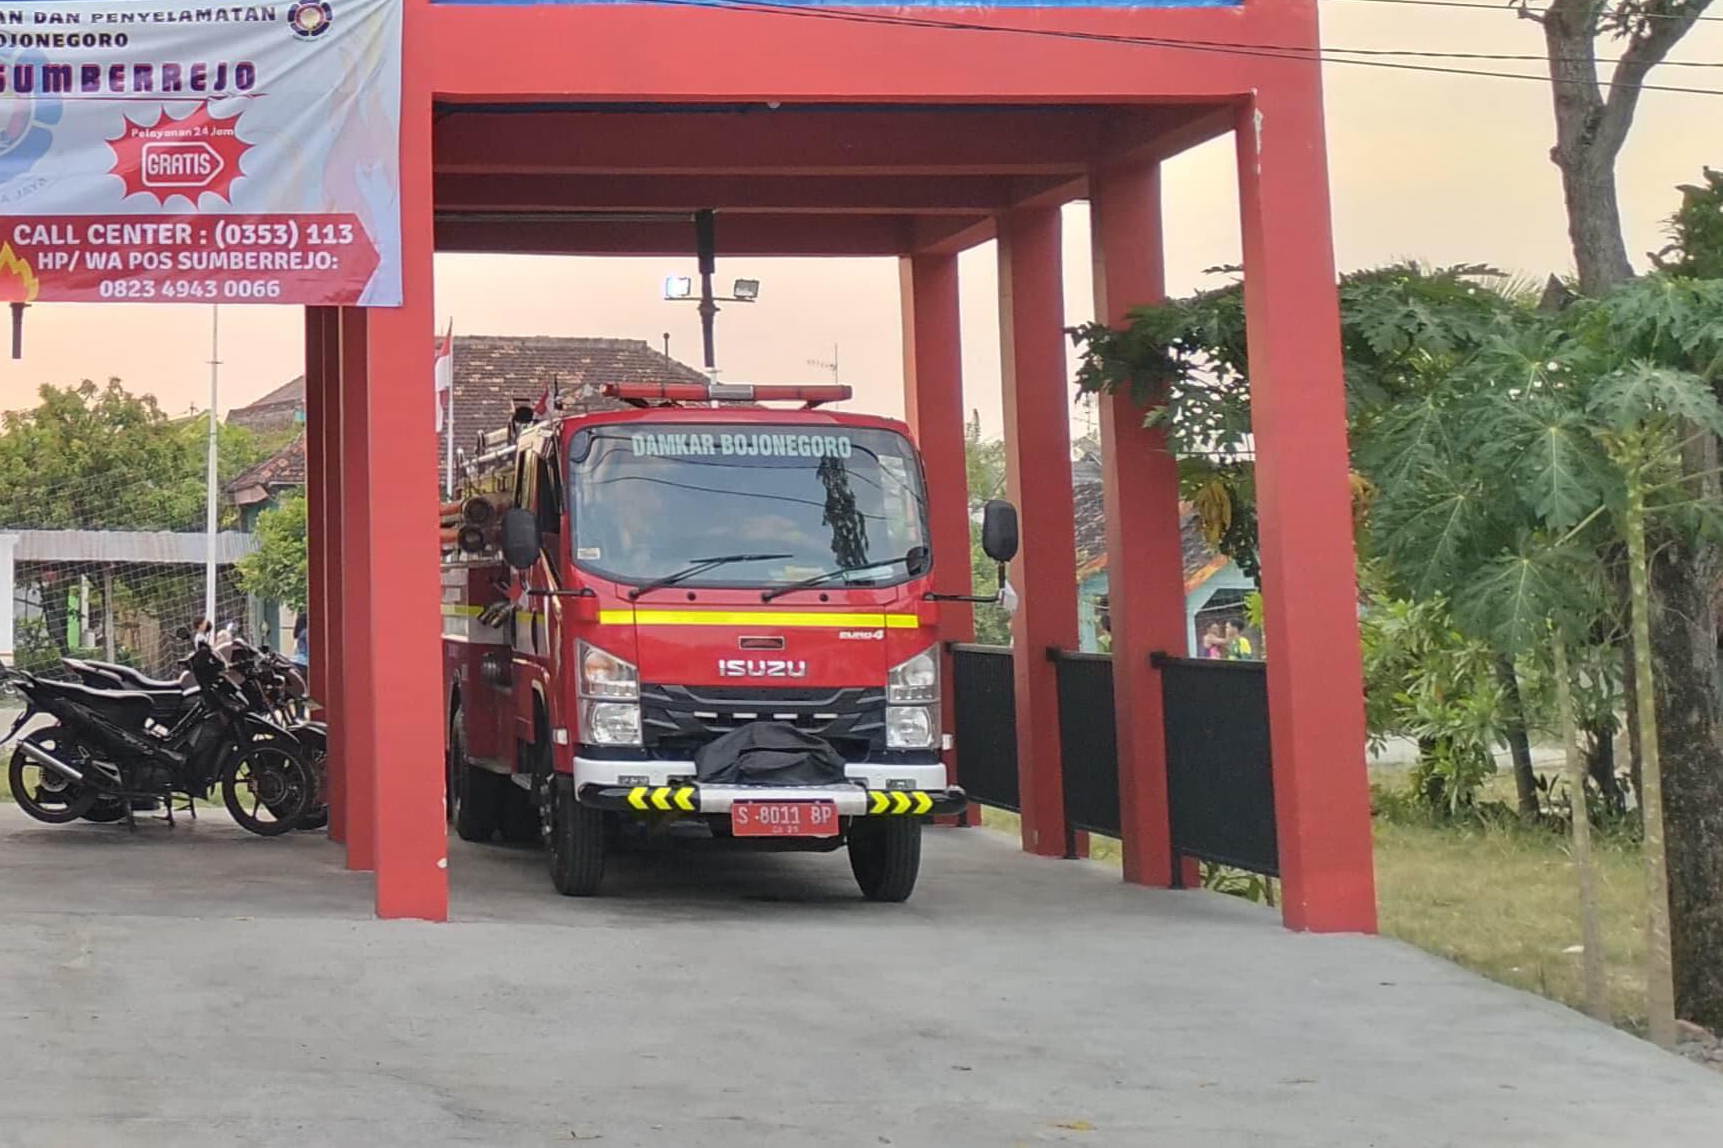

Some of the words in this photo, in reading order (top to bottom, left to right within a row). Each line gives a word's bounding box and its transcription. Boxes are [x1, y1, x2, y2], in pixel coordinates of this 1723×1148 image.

[34, 11, 79, 24] DAN
[91, 6, 276, 24] PENYELAMATAN
[132, 127, 192, 139] Pelayanan
[194, 127, 208, 137] 24
[210, 127, 234, 137] Jam
[147, 153, 211, 175] GRATIS
[14, 224, 80, 246] CALL
[87, 224, 191, 245] CENTER
[215, 220, 299, 249] (0353)
[308, 224, 353, 244] 113
[38, 250, 79, 271] HP/
[85, 252, 123, 269] WA
[129, 252, 173, 270] POS
[178, 251, 338, 270] SUMBERREJO:
[100, 280, 154, 297] 0823
[162, 280, 218, 297] 4943
[224, 280, 280, 297] 0066
[631, 434, 715, 456] DAMKAR
[720, 434, 852, 458] BOJONEGORO
[718, 660, 806, 676] ISUZU
[737, 806, 748, 824] S
[760, 806, 800, 824] 8011
[811, 806, 831, 824] BP
